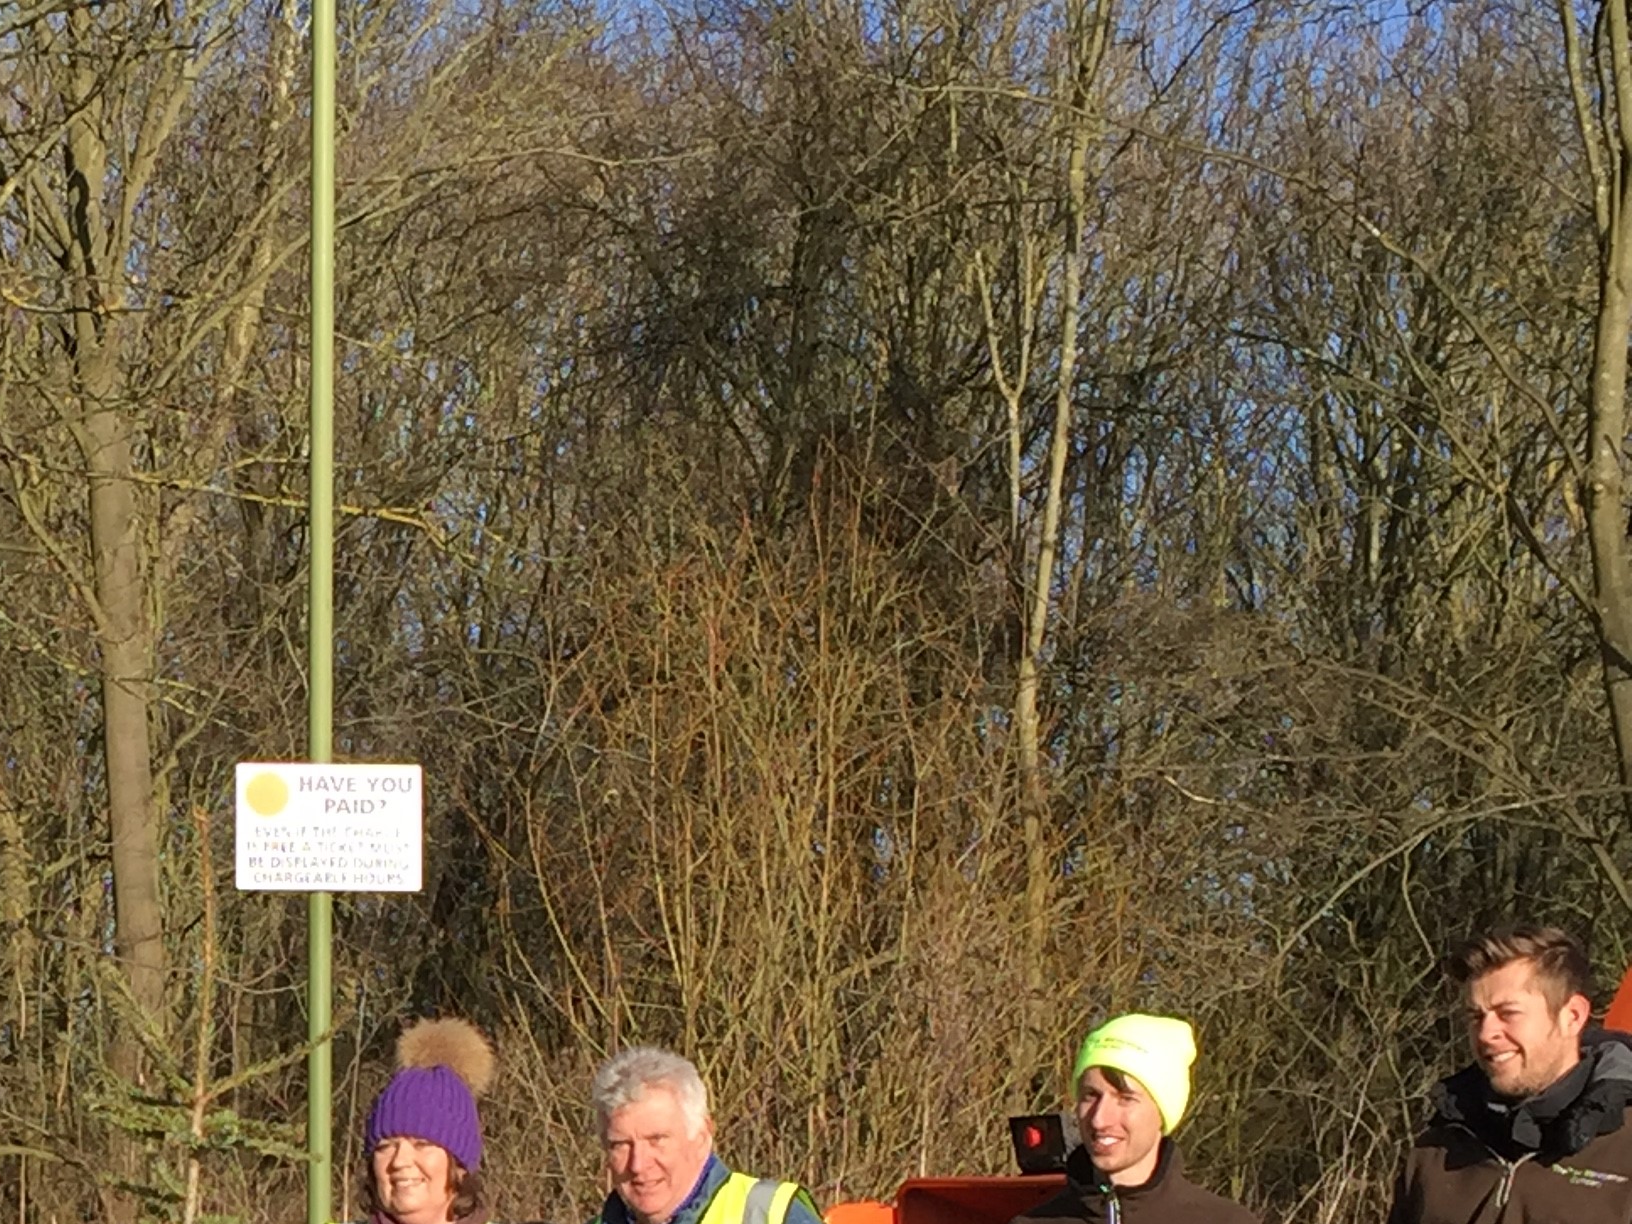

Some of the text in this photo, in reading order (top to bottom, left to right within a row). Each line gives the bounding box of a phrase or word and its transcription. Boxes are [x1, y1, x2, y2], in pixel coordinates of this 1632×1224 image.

[299, 776, 413, 794] HAVE YOU
[302, 841, 312, 852] A
[248, 857, 409, 870] BE DISPLAYED DURING
[254, 871, 404, 885] CHARGEABLE HOURS
